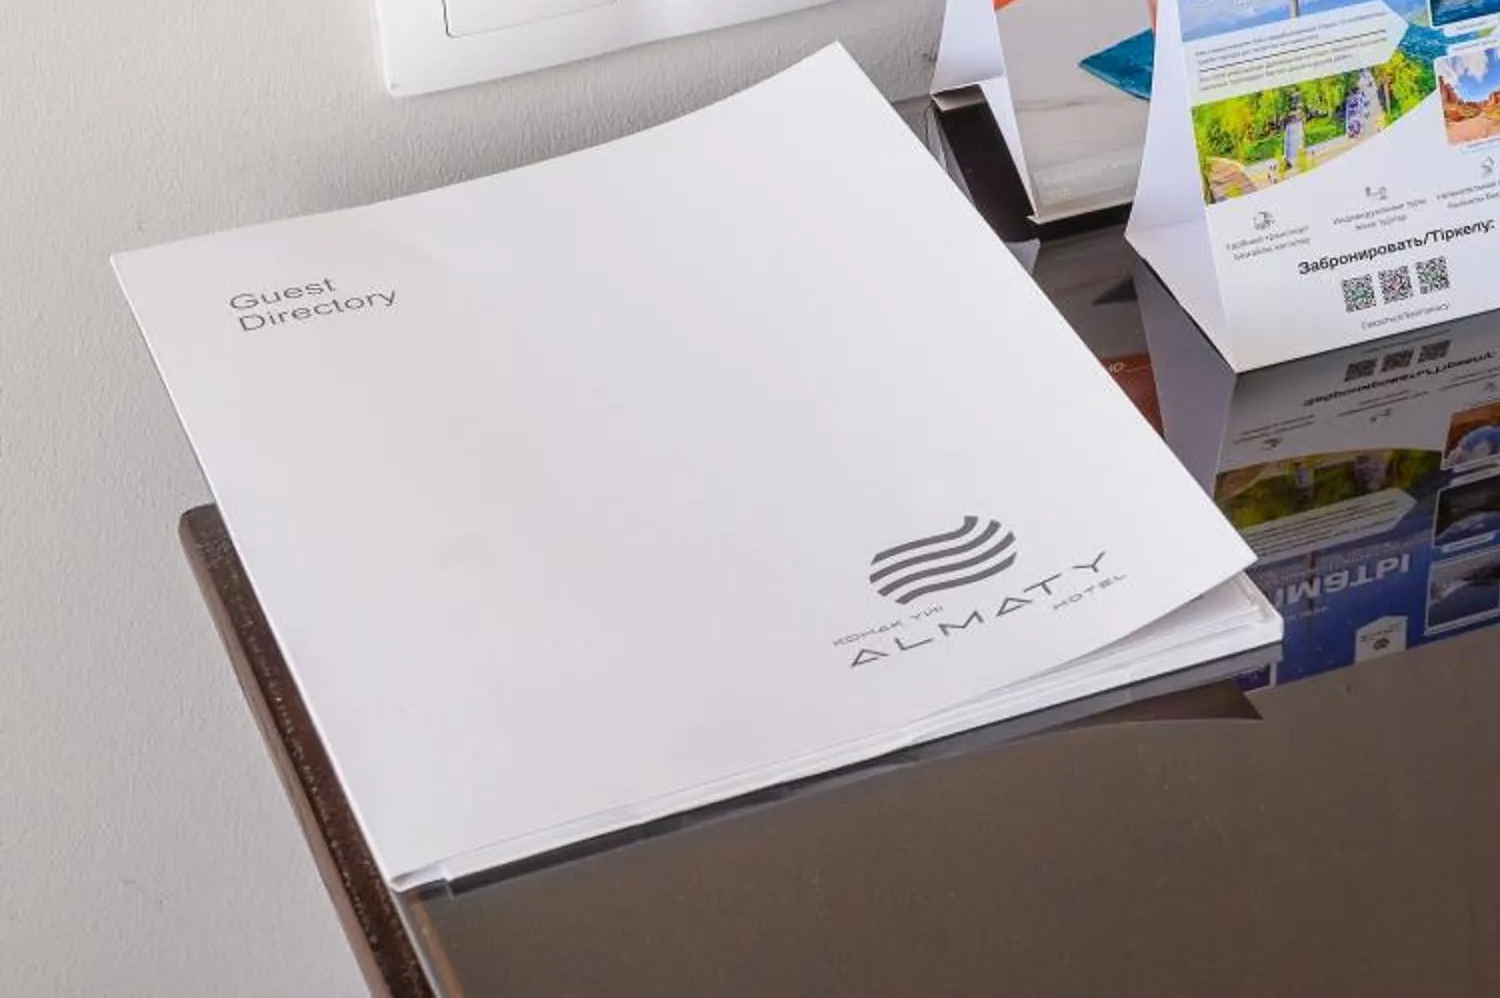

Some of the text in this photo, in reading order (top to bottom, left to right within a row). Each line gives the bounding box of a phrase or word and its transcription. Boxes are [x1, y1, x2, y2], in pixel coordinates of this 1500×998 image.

[1298, 219, 1496, 276] Забронировать/Тіркелу:
[230, 277, 337, 309] Guest
[239, 290, 396, 331] Directory
[850, 551, 1107, 668] ALMATY
[1053, 573, 1127, 611] HOTEL
